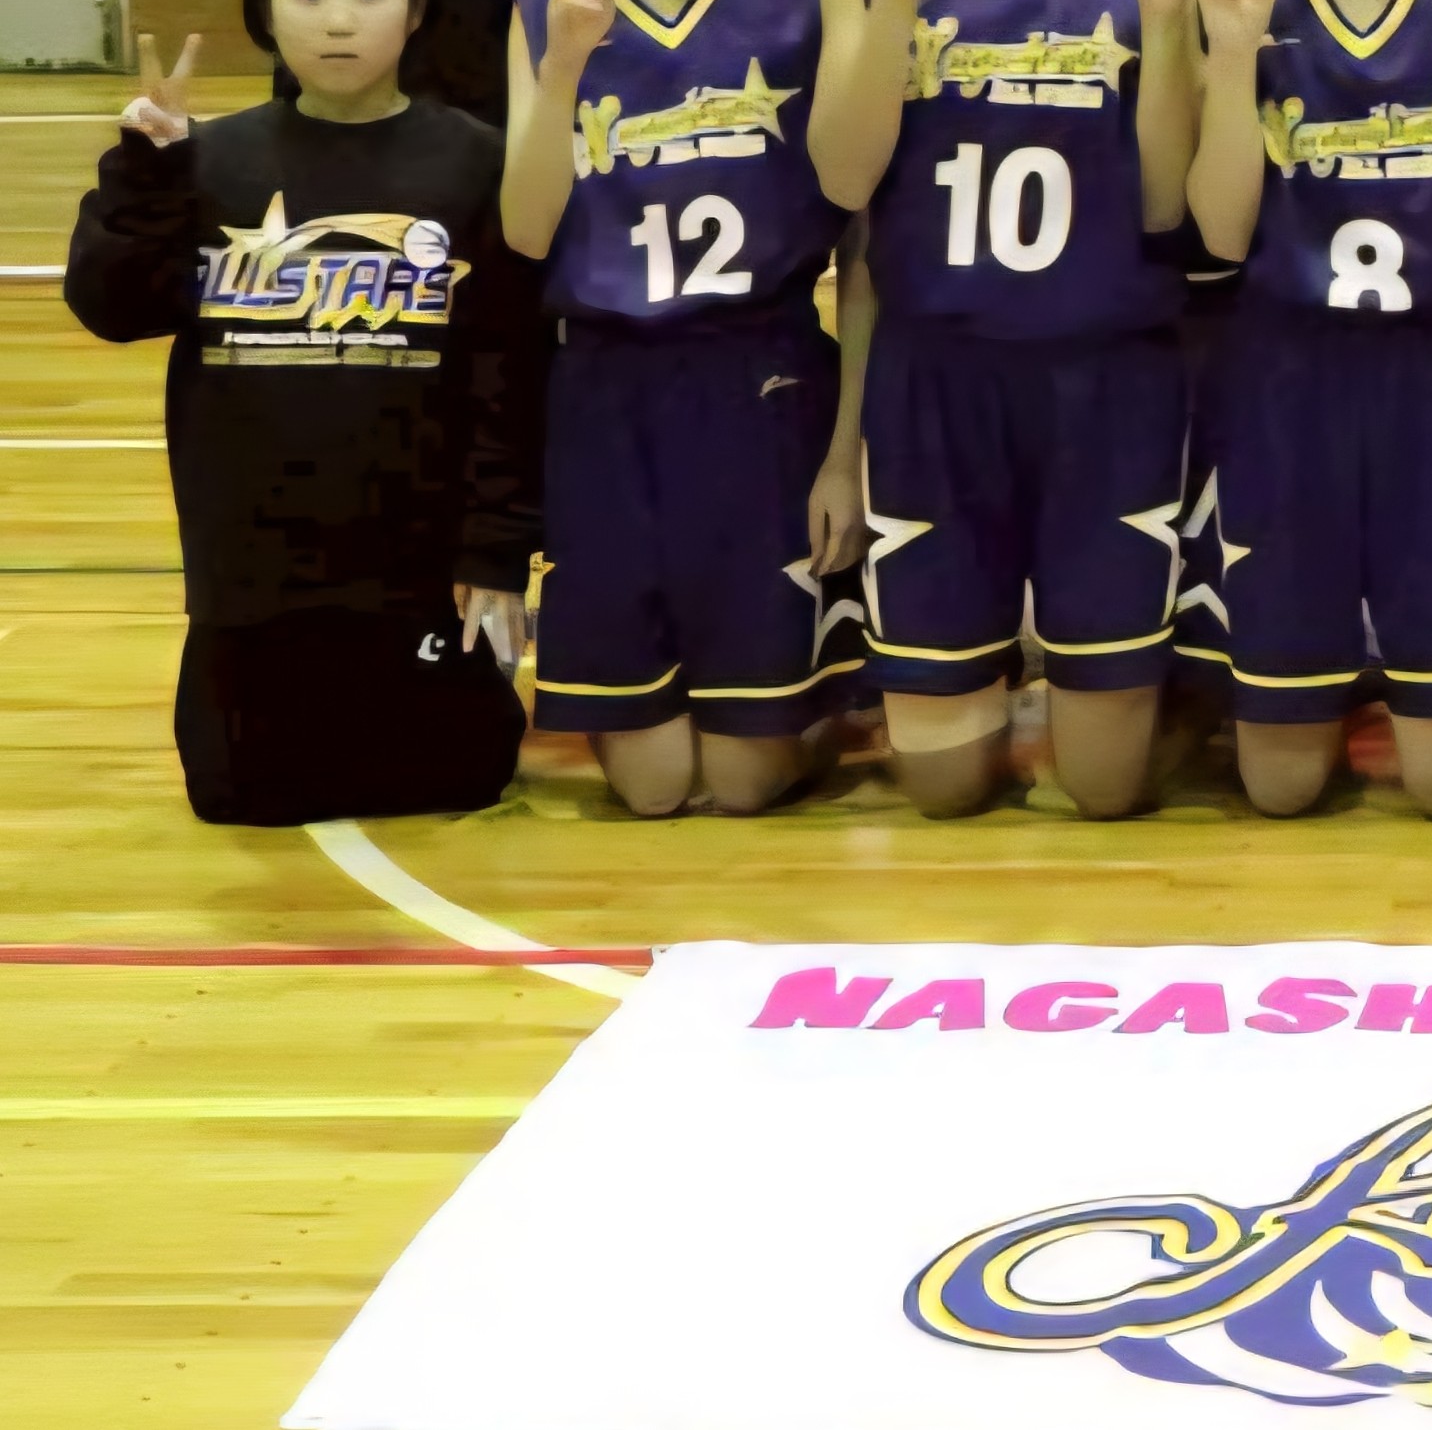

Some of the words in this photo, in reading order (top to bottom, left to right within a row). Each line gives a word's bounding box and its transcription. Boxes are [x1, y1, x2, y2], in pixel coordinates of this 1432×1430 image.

[630, 194, 753, 303] 12
[935, 143, 1072, 272] 10
[1327, 218, 1413, 312] 8
